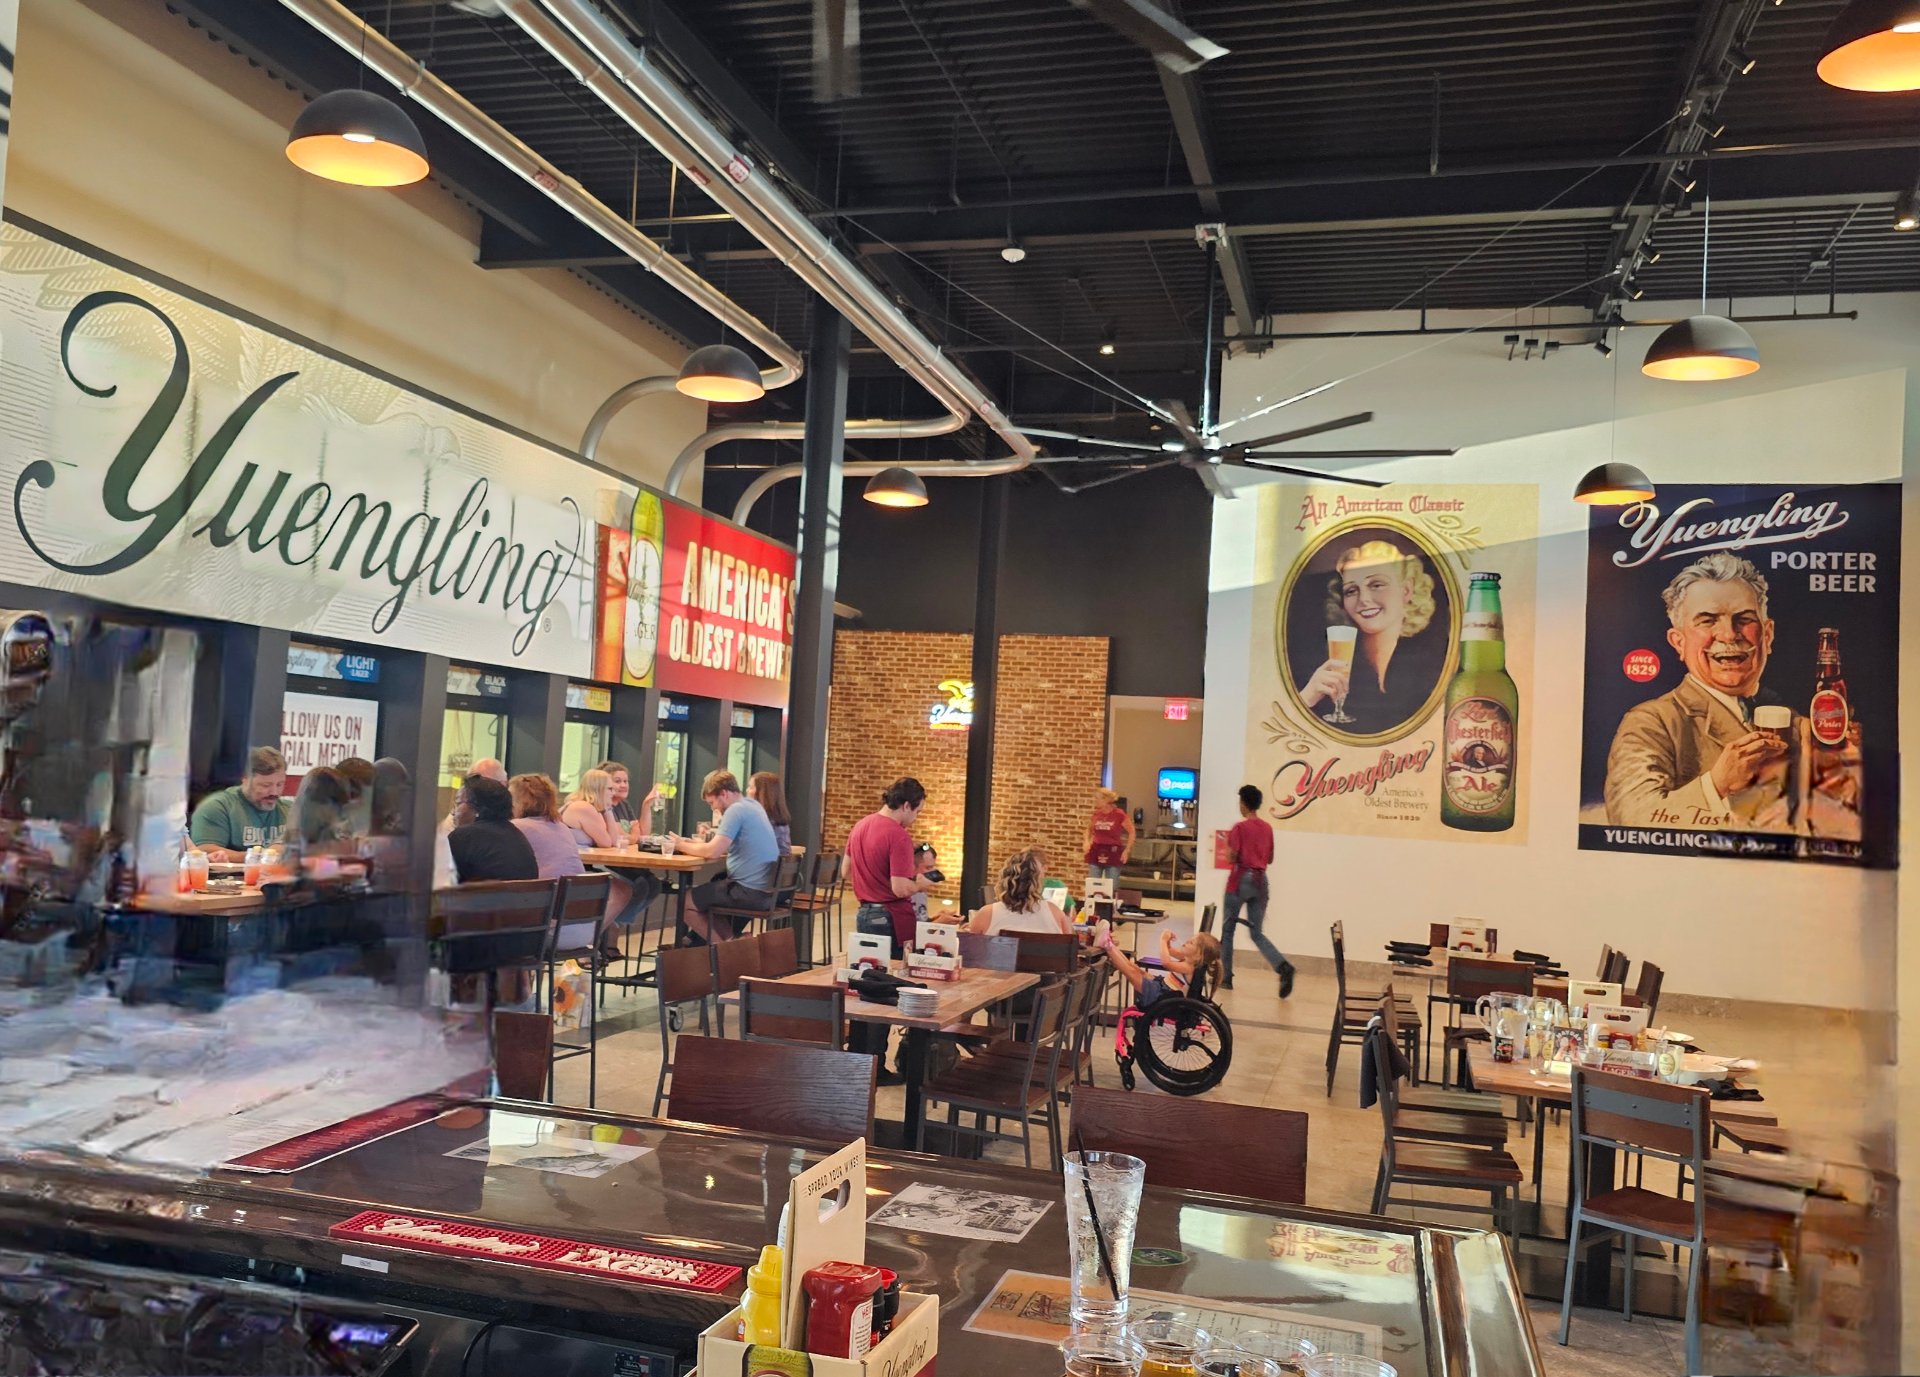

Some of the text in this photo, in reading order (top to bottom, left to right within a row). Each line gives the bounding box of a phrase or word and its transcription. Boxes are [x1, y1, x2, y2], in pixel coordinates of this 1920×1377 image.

[14, 290, 581, 657] Yuengling
[1295, 495, 1465, 532] An American Classic
[1612, 492, 1849, 568] Yuengling
[1771, 551, 1877, 571] PORTER
[1809, 574, 1876, 593] BEER
[669, 615, 734, 671] OLDEST
[346, 655, 376, 671] LIGHT
[1630, 655, 1653, 664] SINCE
[1626, 664, 1657, 676] 1829
[484, 674, 506, 687] BLACK
[670, 704, 688, 715] FLIGHT
[324, 714, 341, 739] US
[345, 716, 362, 740] ON
[281, 740, 313, 767] CIAL
[1269, 740, 1435, 819] Yuengling
[1456, 775, 1497, 793] Ale
[1383, 787, 1425, 798] America's
[1364, 797, 1430, 812] Oldest Brewery
[1650, 807, 1680, 824] the
[807, 1155, 859, 1196] SPREAD YOUR WINGS
[555, 1251, 698, 1284] LAGER
